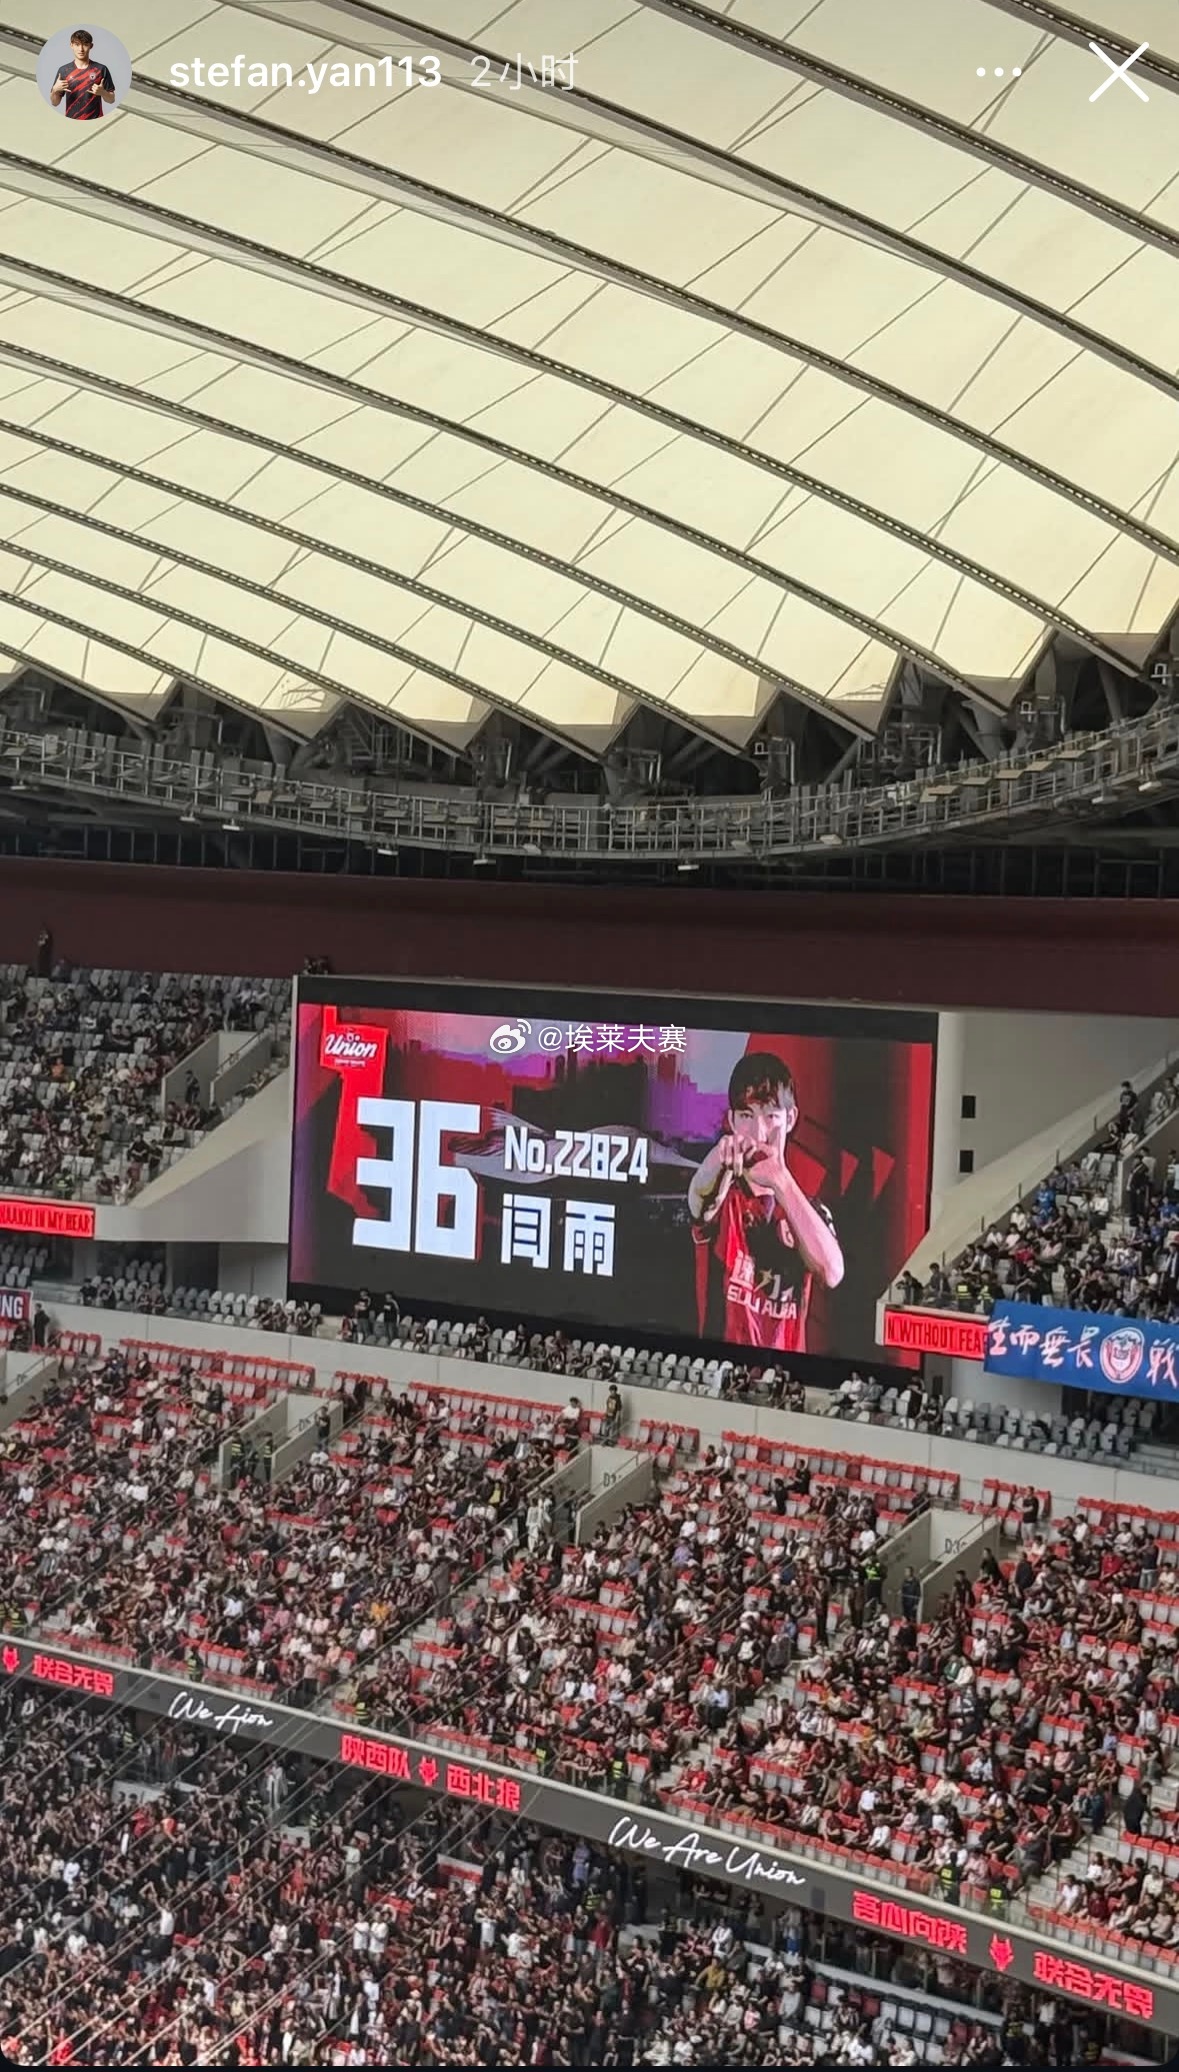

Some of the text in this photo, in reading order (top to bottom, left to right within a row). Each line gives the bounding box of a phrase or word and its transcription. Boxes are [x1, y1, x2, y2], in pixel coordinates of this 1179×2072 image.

[325, 1033, 378, 1058] Union
[504, 1124, 649, 1184] No.22824
[352, 1096, 481, 1260] 36
[66, 1212, 94, 1234] HEAR
[501, 1193, 616, 1277] 闫雨
[900, 1320, 955, 1352] WITHOUT
[31, 1654, 115, 1697] 联合无畏
[168, 1691, 214, 1720] We
[340, 1734, 411, 1780] 陕西队
[447, 1763, 521, 1812] 西北狼
[608, 1816, 806, 1885] We Are Union
[1033, 1951, 1154, 2019] 联合无畏
